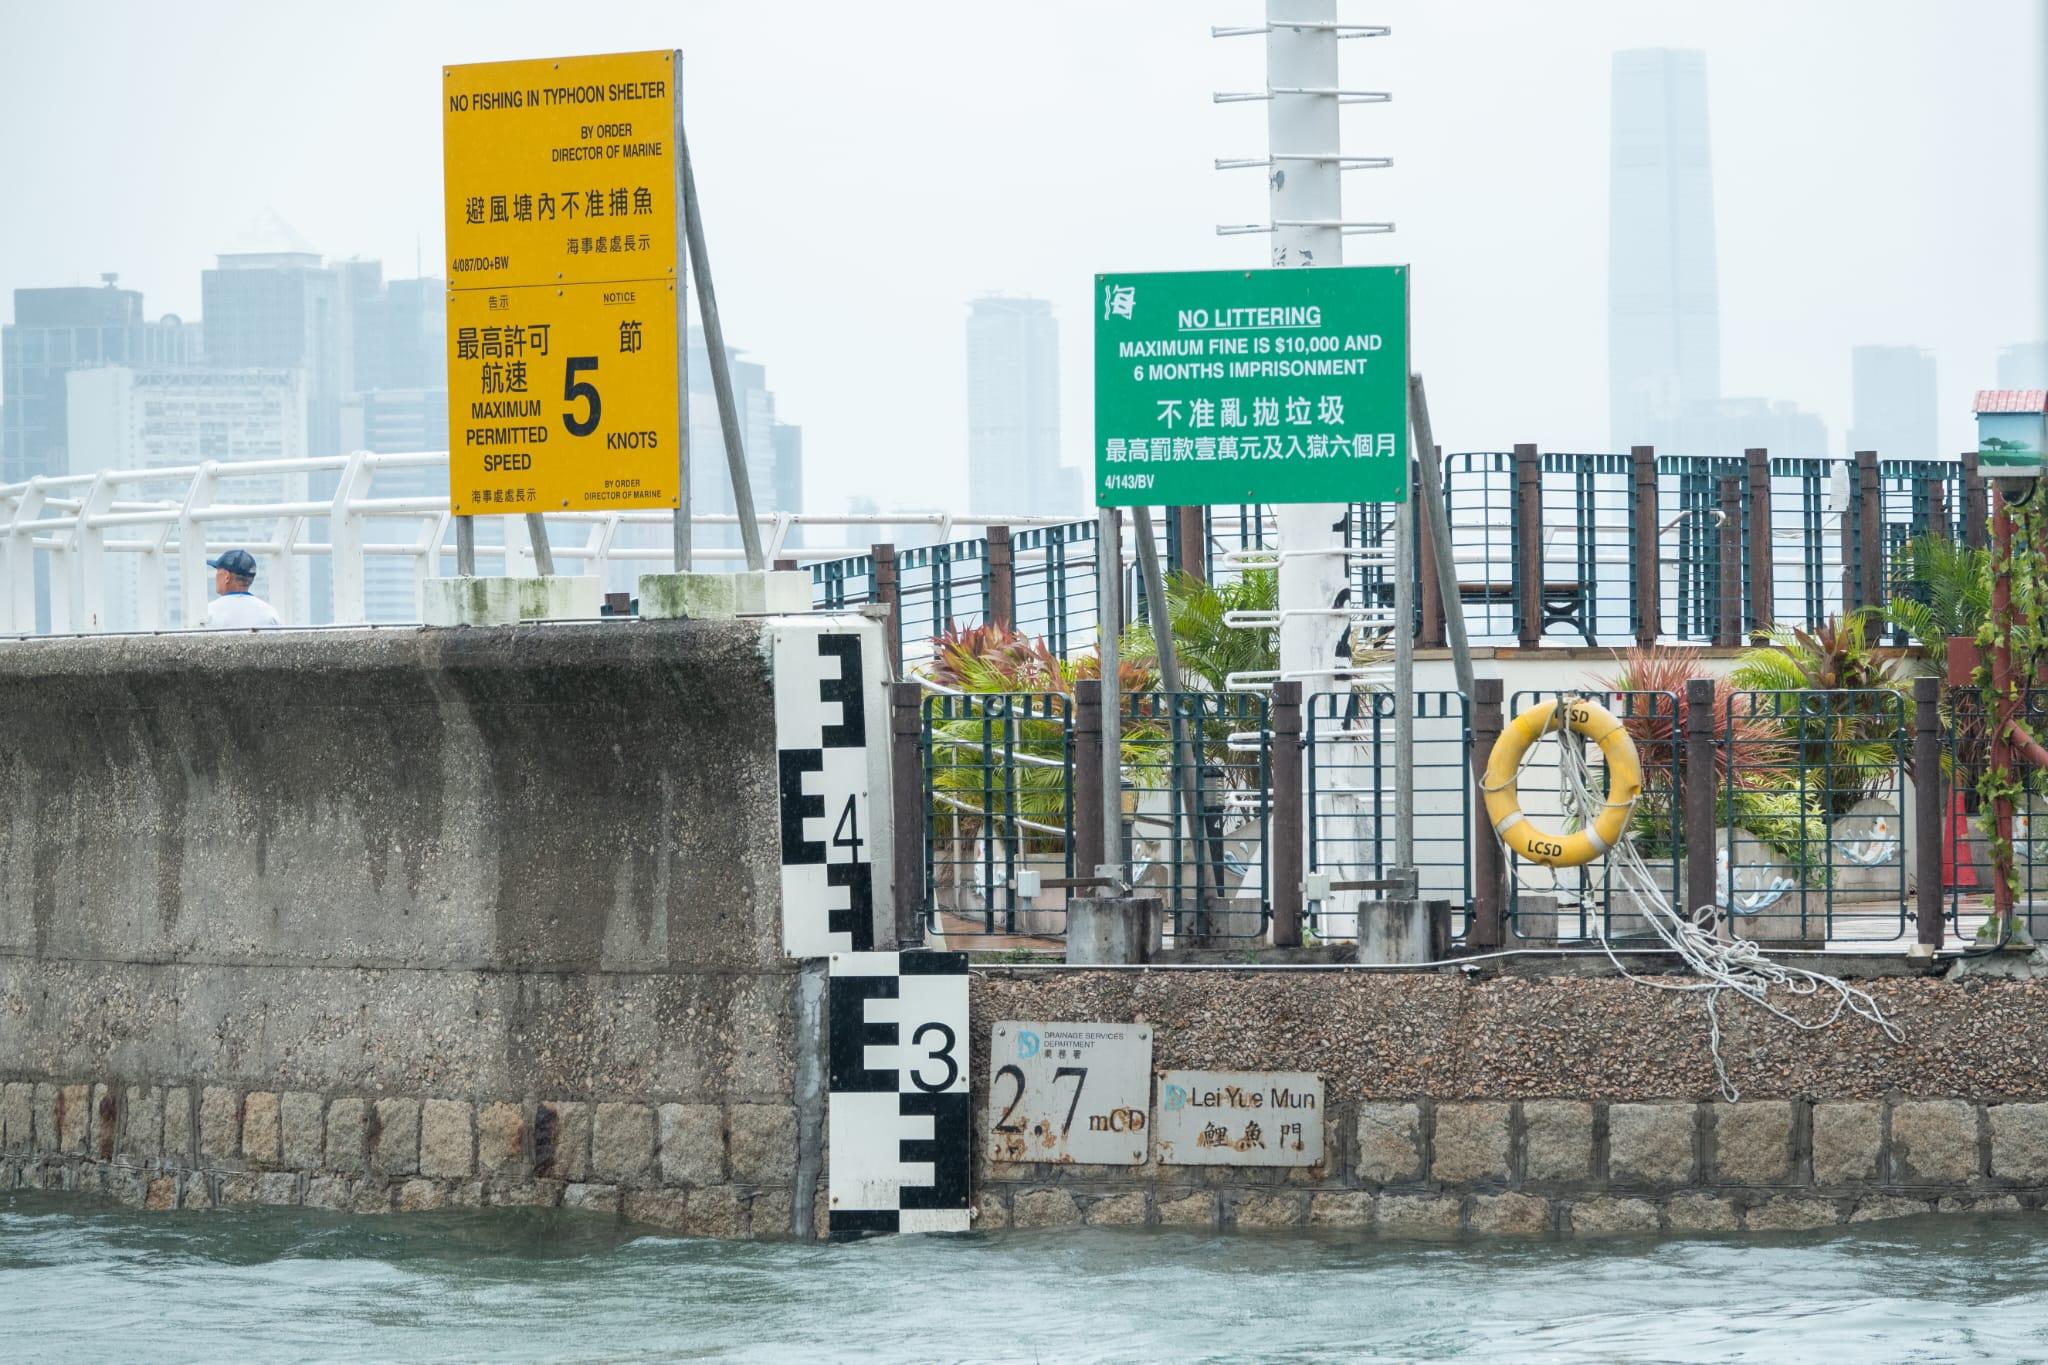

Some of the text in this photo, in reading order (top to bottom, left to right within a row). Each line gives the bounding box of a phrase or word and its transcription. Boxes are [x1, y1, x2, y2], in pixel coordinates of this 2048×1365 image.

[450, 81, 664, 111] NO FISHING IN TYPHOON SHELTER
[581, 123, 631, 139] BY ORDER
[552, 143, 661, 162] DIRECTOR OF MARINE
[467, 187, 652, 224] 避風塘內不准捕魚
[567, 235, 649, 254] 海事處處長示
[453, 256, 508, 272] 4/087/DO+BW
[489, 295, 508, 308] 告示
[604, 292, 635, 302] NOTICE
[1178, 306, 1321, 328] NO LITTERING
[457, 324, 550, 360] 最高許可
[620, 320, 641, 352] 節
[1120, 335, 1381, 357] MAXIMUM FINE IS $10,000 AND
[481, 361, 528, 394] 航速
[1134, 359, 1367, 381] 6 MONTHS IMPRISONMENT
[563, 356, 601, 437] 5
[472, 400, 541, 419] MAXIMUM
[467, 426, 547, 445] PERMITTED
[608, 431, 657, 449] KNOTS
[484, 454, 531, 471] SPEED
[605, 480, 640, 488] BY ORDER
[1105, 474, 1154, 488] 4/143/BV
[585, 490, 661, 500] DIRECTOR OF MARINE
[833, 794, 864, 864] 4
[1527, 840, 1562, 857] LCSD
[910, 1022, 958, 1093] 3
[992, 1064, 1146, 1136] 2.7 mCD
[1192, 1088, 1315, 1109] Lei Yue Mun
[1204, 1121, 1304, 1151] 鯉魚門
